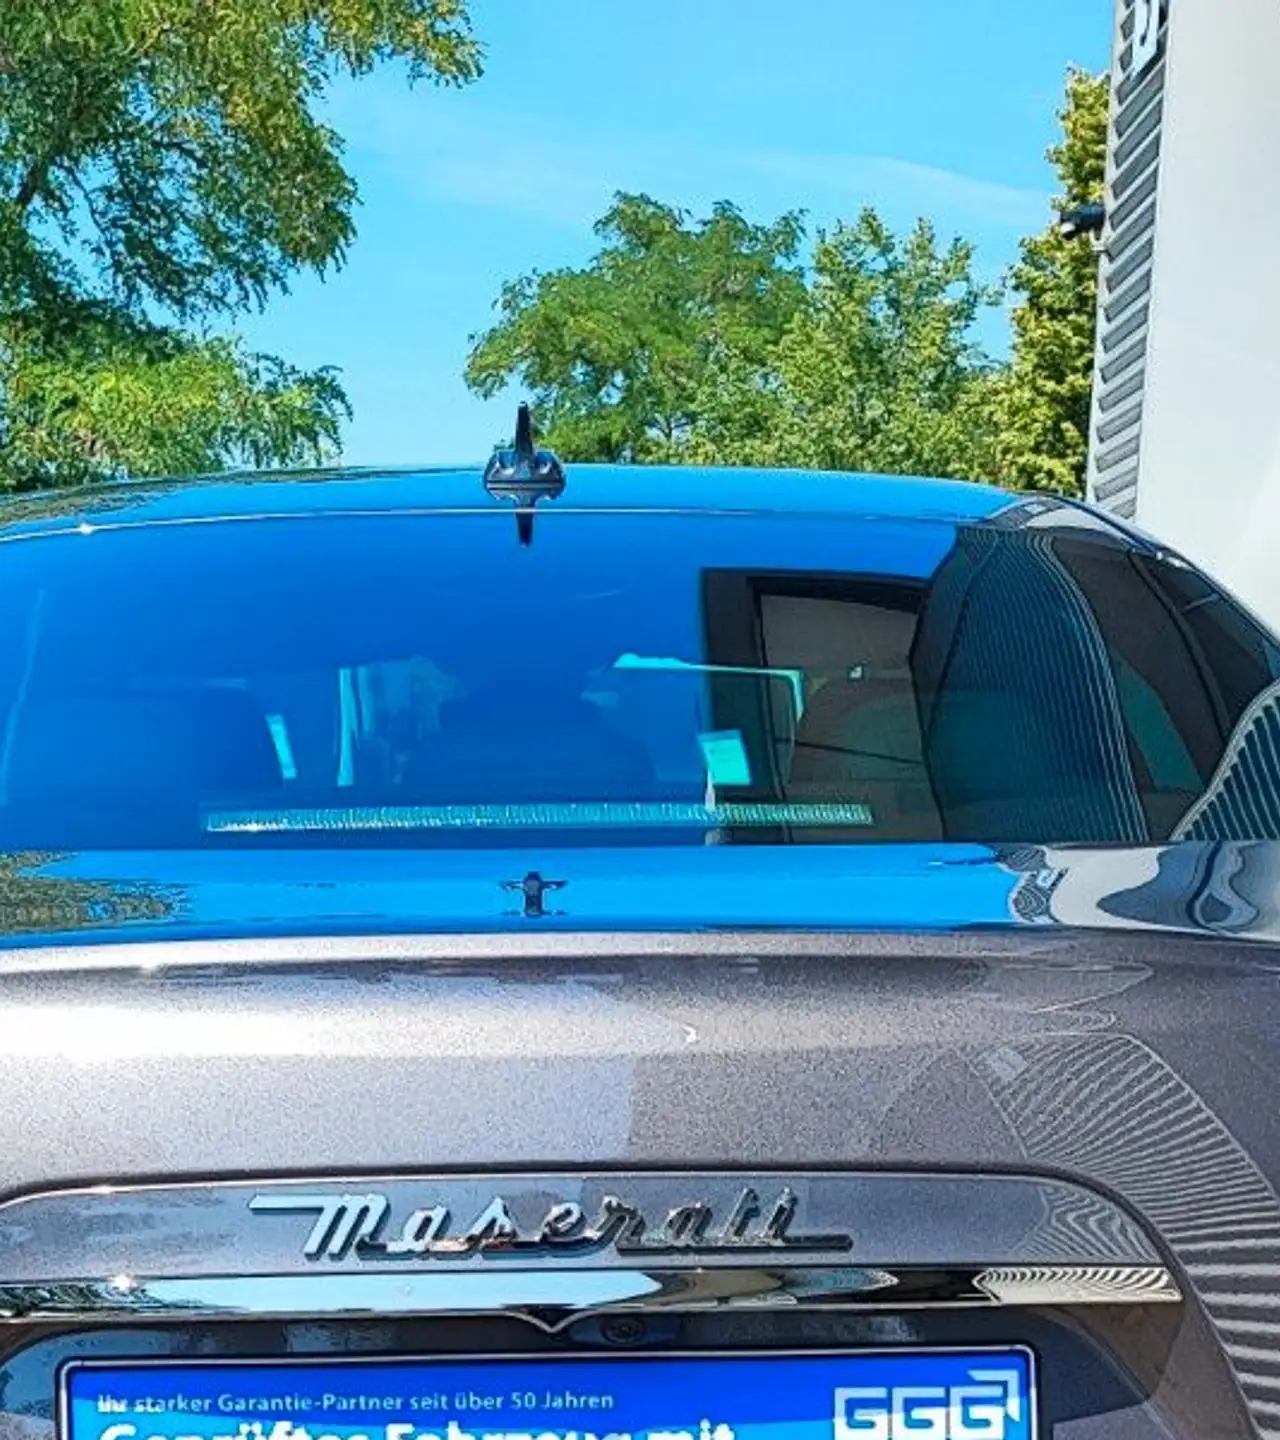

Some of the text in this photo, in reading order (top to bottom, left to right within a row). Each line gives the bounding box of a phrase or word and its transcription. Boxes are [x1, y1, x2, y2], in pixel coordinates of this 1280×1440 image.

[250, 1188, 853, 1262] Maserati
[97, 1391, 614, 1413] Ihr starker Garantie-Partner seit über 50 Jahren
